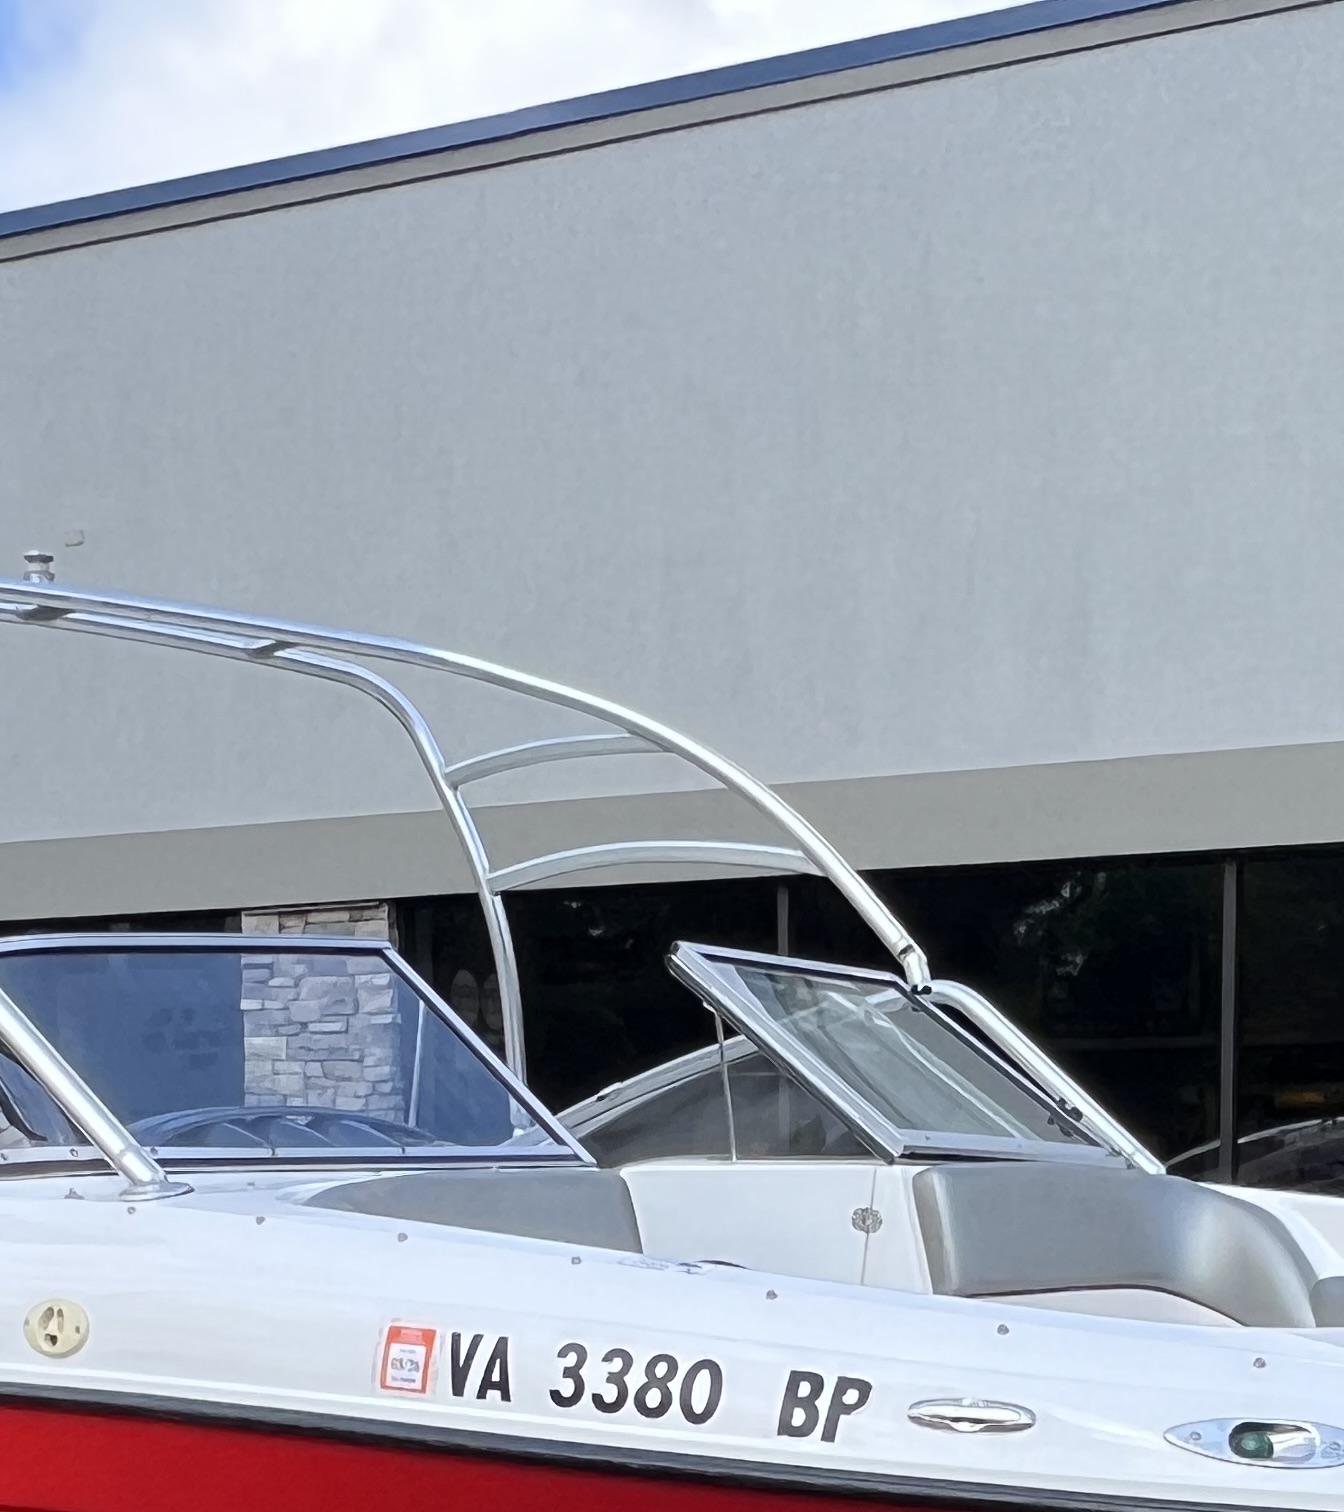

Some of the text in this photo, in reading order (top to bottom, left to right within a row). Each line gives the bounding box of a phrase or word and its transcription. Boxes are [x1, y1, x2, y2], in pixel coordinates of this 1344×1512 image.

[449, 1331, 874, 1444] VA 3380 BP
